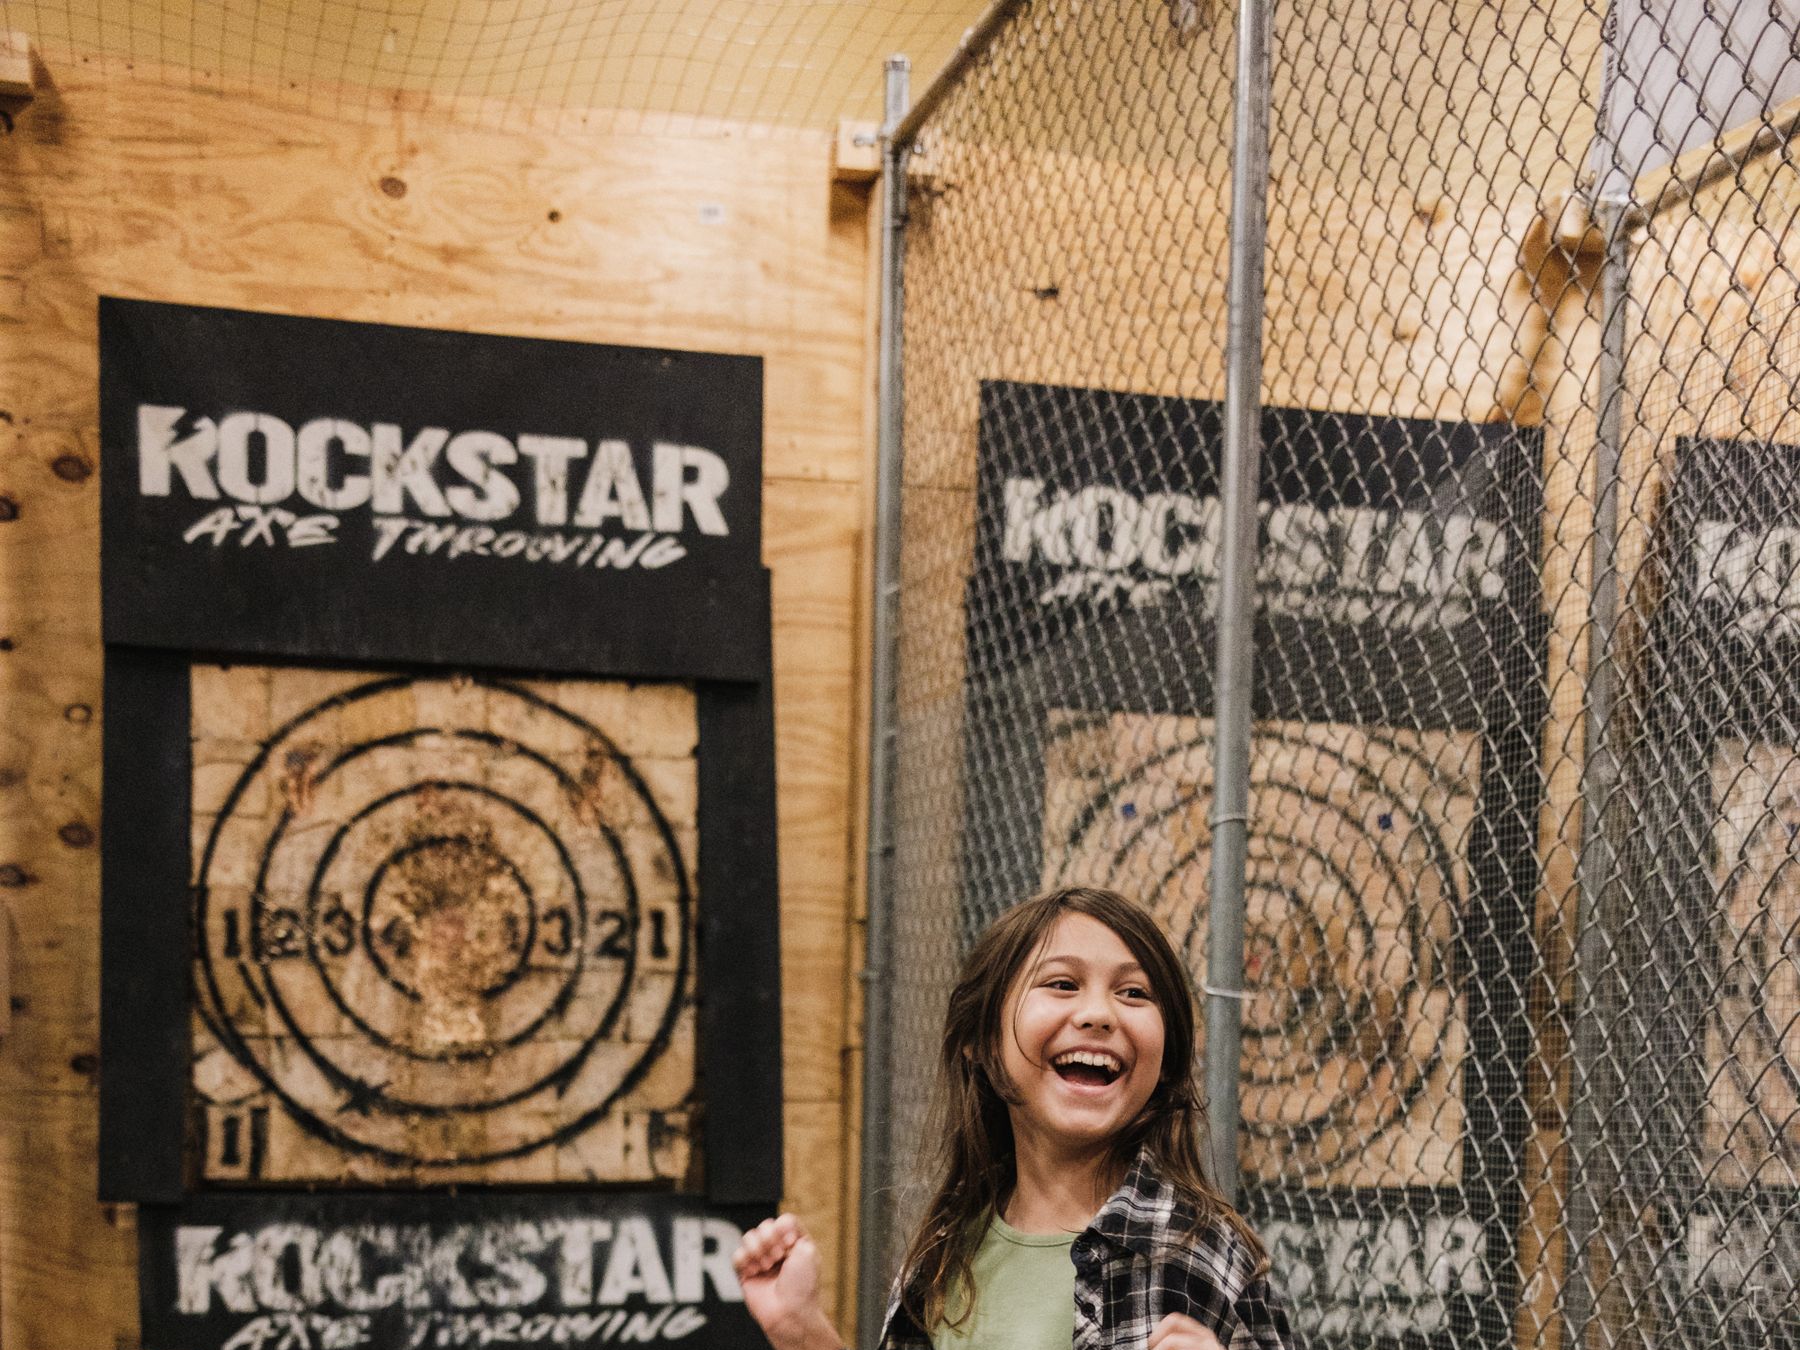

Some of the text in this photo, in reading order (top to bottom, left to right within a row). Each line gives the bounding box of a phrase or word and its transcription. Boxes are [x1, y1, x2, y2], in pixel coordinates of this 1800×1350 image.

[137, 403, 731, 536] ROCKSTAR
[183, 505, 688, 570] AXE THROWING
[594, 909, 631, 958] 2
